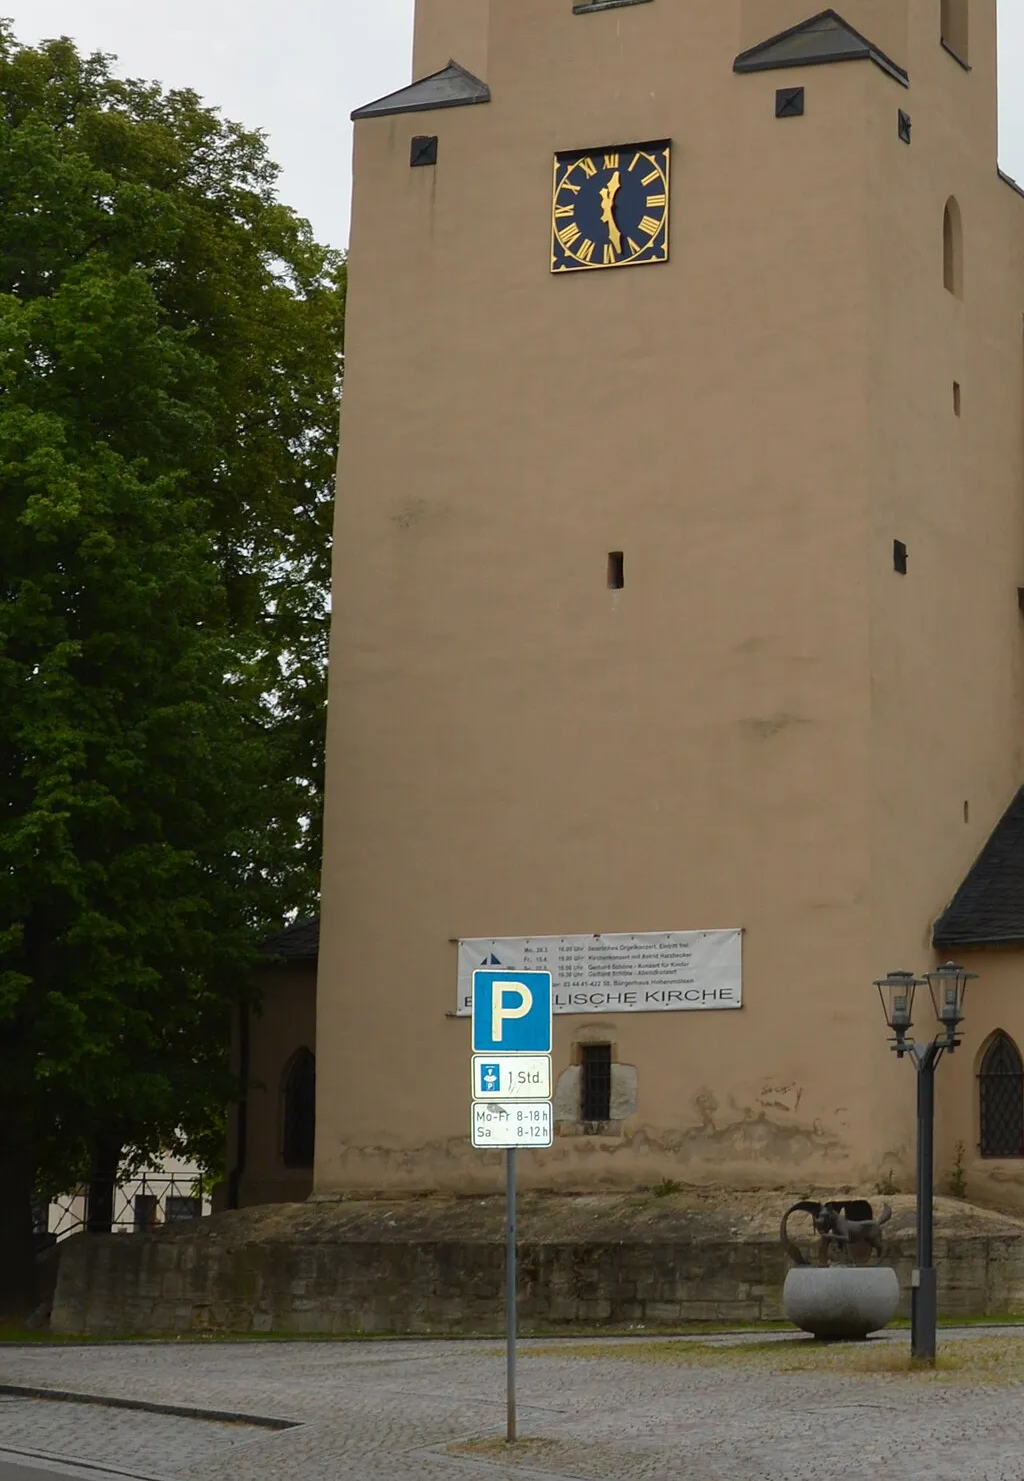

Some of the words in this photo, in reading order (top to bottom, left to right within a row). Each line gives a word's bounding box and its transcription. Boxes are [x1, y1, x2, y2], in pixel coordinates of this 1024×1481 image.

[578, 157, 597, 179] XI
[603, 153, 618, 169] XII
[641, 169, 660, 186] II
[561, 179, 581, 195] X
[646, 195, 665, 207] III
[555, 204, 574, 217] IX
[638, 215, 660, 236] IIII
[558, 222, 582, 247] VIII
[576, 239, 595, 261] VII
[604, 244, 615, 264] VI
[645, 988, 734, 1003] KIRCHE
[491, 981, 533, 1042] P
[508, 1071, 513, 1084] 1
[517, 1071, 544, 1084] Std.
[476, 1111, 510, 1122] Mo-Fr
[516, 1110, 541, 1122] 8-18
[542, 1110, 548, 1122] h
[477, 1127, 492, 1138] Sa
[517, 1126, 541, 1137] 8-12
[542, 1126, 549, 1137] h
